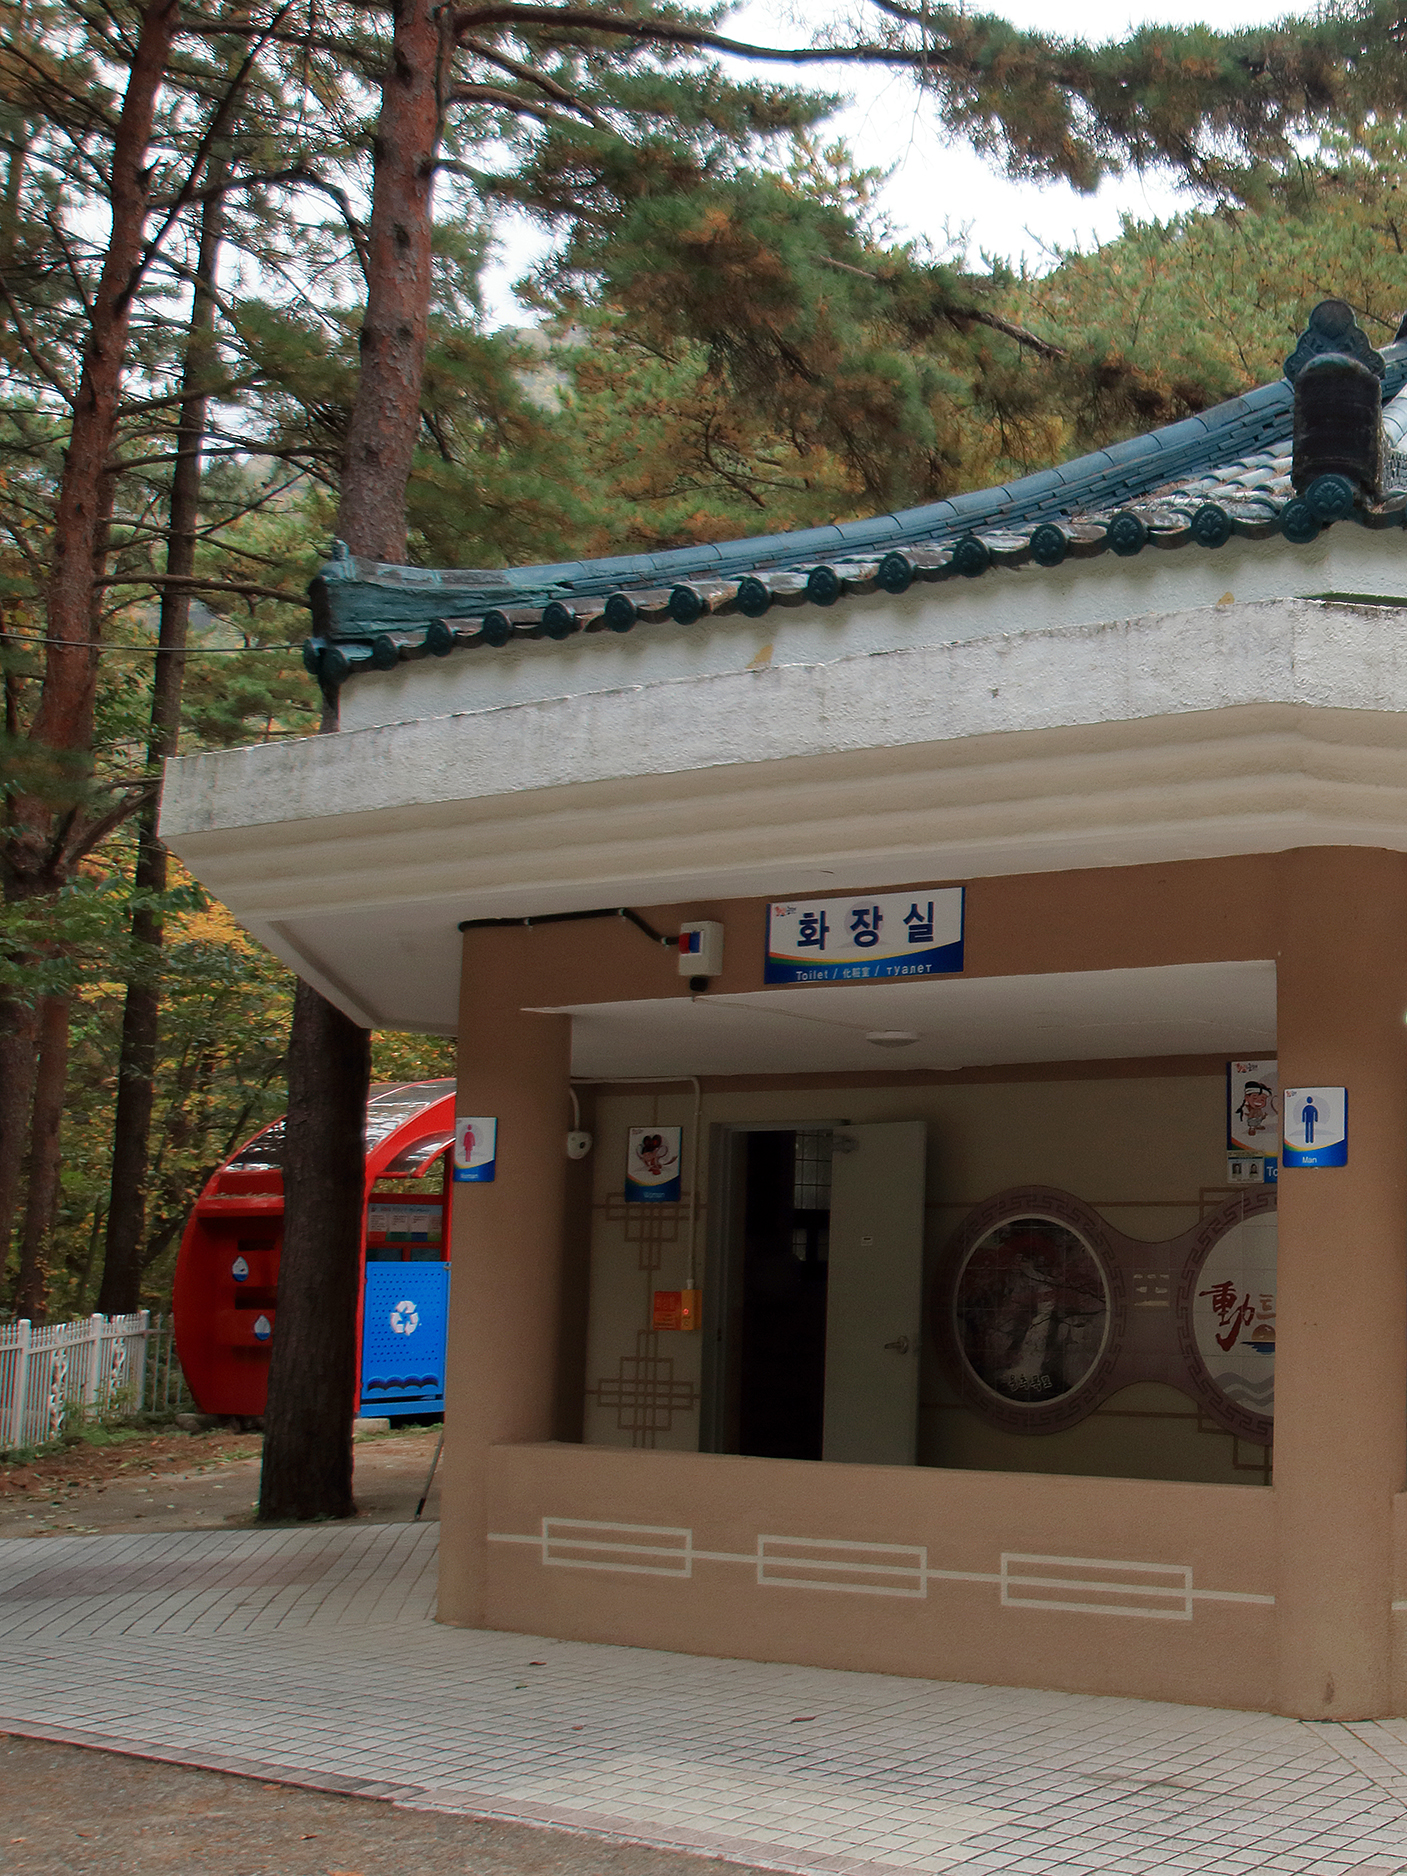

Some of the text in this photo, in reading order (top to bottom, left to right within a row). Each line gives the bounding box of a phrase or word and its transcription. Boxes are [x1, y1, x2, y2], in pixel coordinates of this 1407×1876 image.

[797, 901, 934, 950] 화장실
[796, 970, 829, 981] Toilet
[886, 964, 933, 977] туалет
[1302, 1156, 1318, 1164] Man
